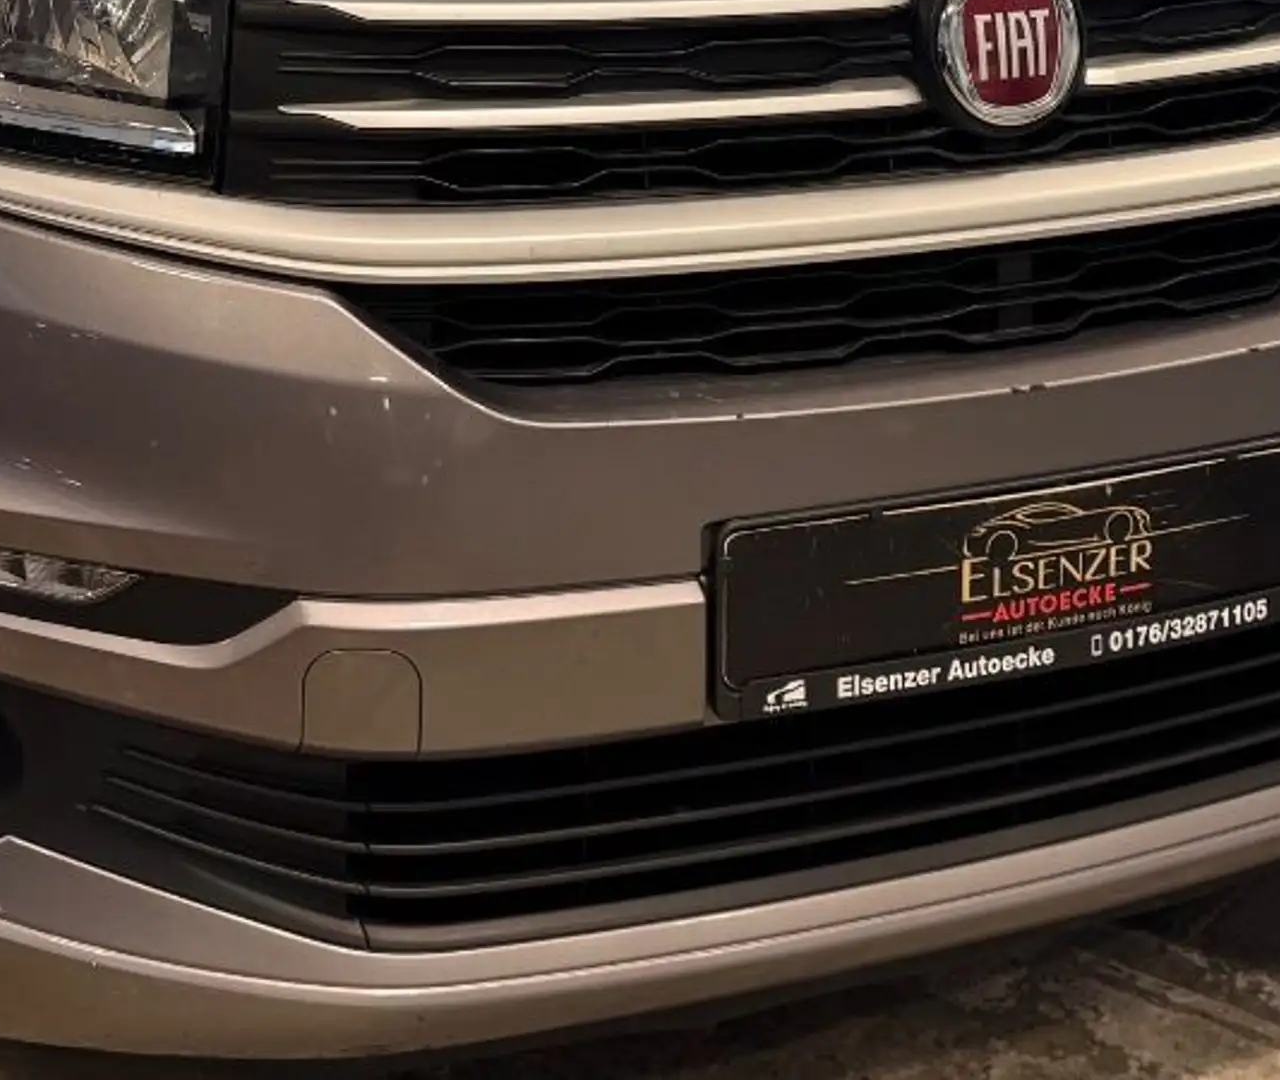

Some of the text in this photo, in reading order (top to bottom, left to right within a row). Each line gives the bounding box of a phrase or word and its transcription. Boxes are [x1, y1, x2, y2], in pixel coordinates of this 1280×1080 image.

[973, 9, 1050, 81] FIAT
[961, 539, 1154, 604] ELSENZER
[992, 582, 1117, 623] AUTOECKE
[836, 598, 1269, 699] Elsenzer Autoecke 0176/32871105
